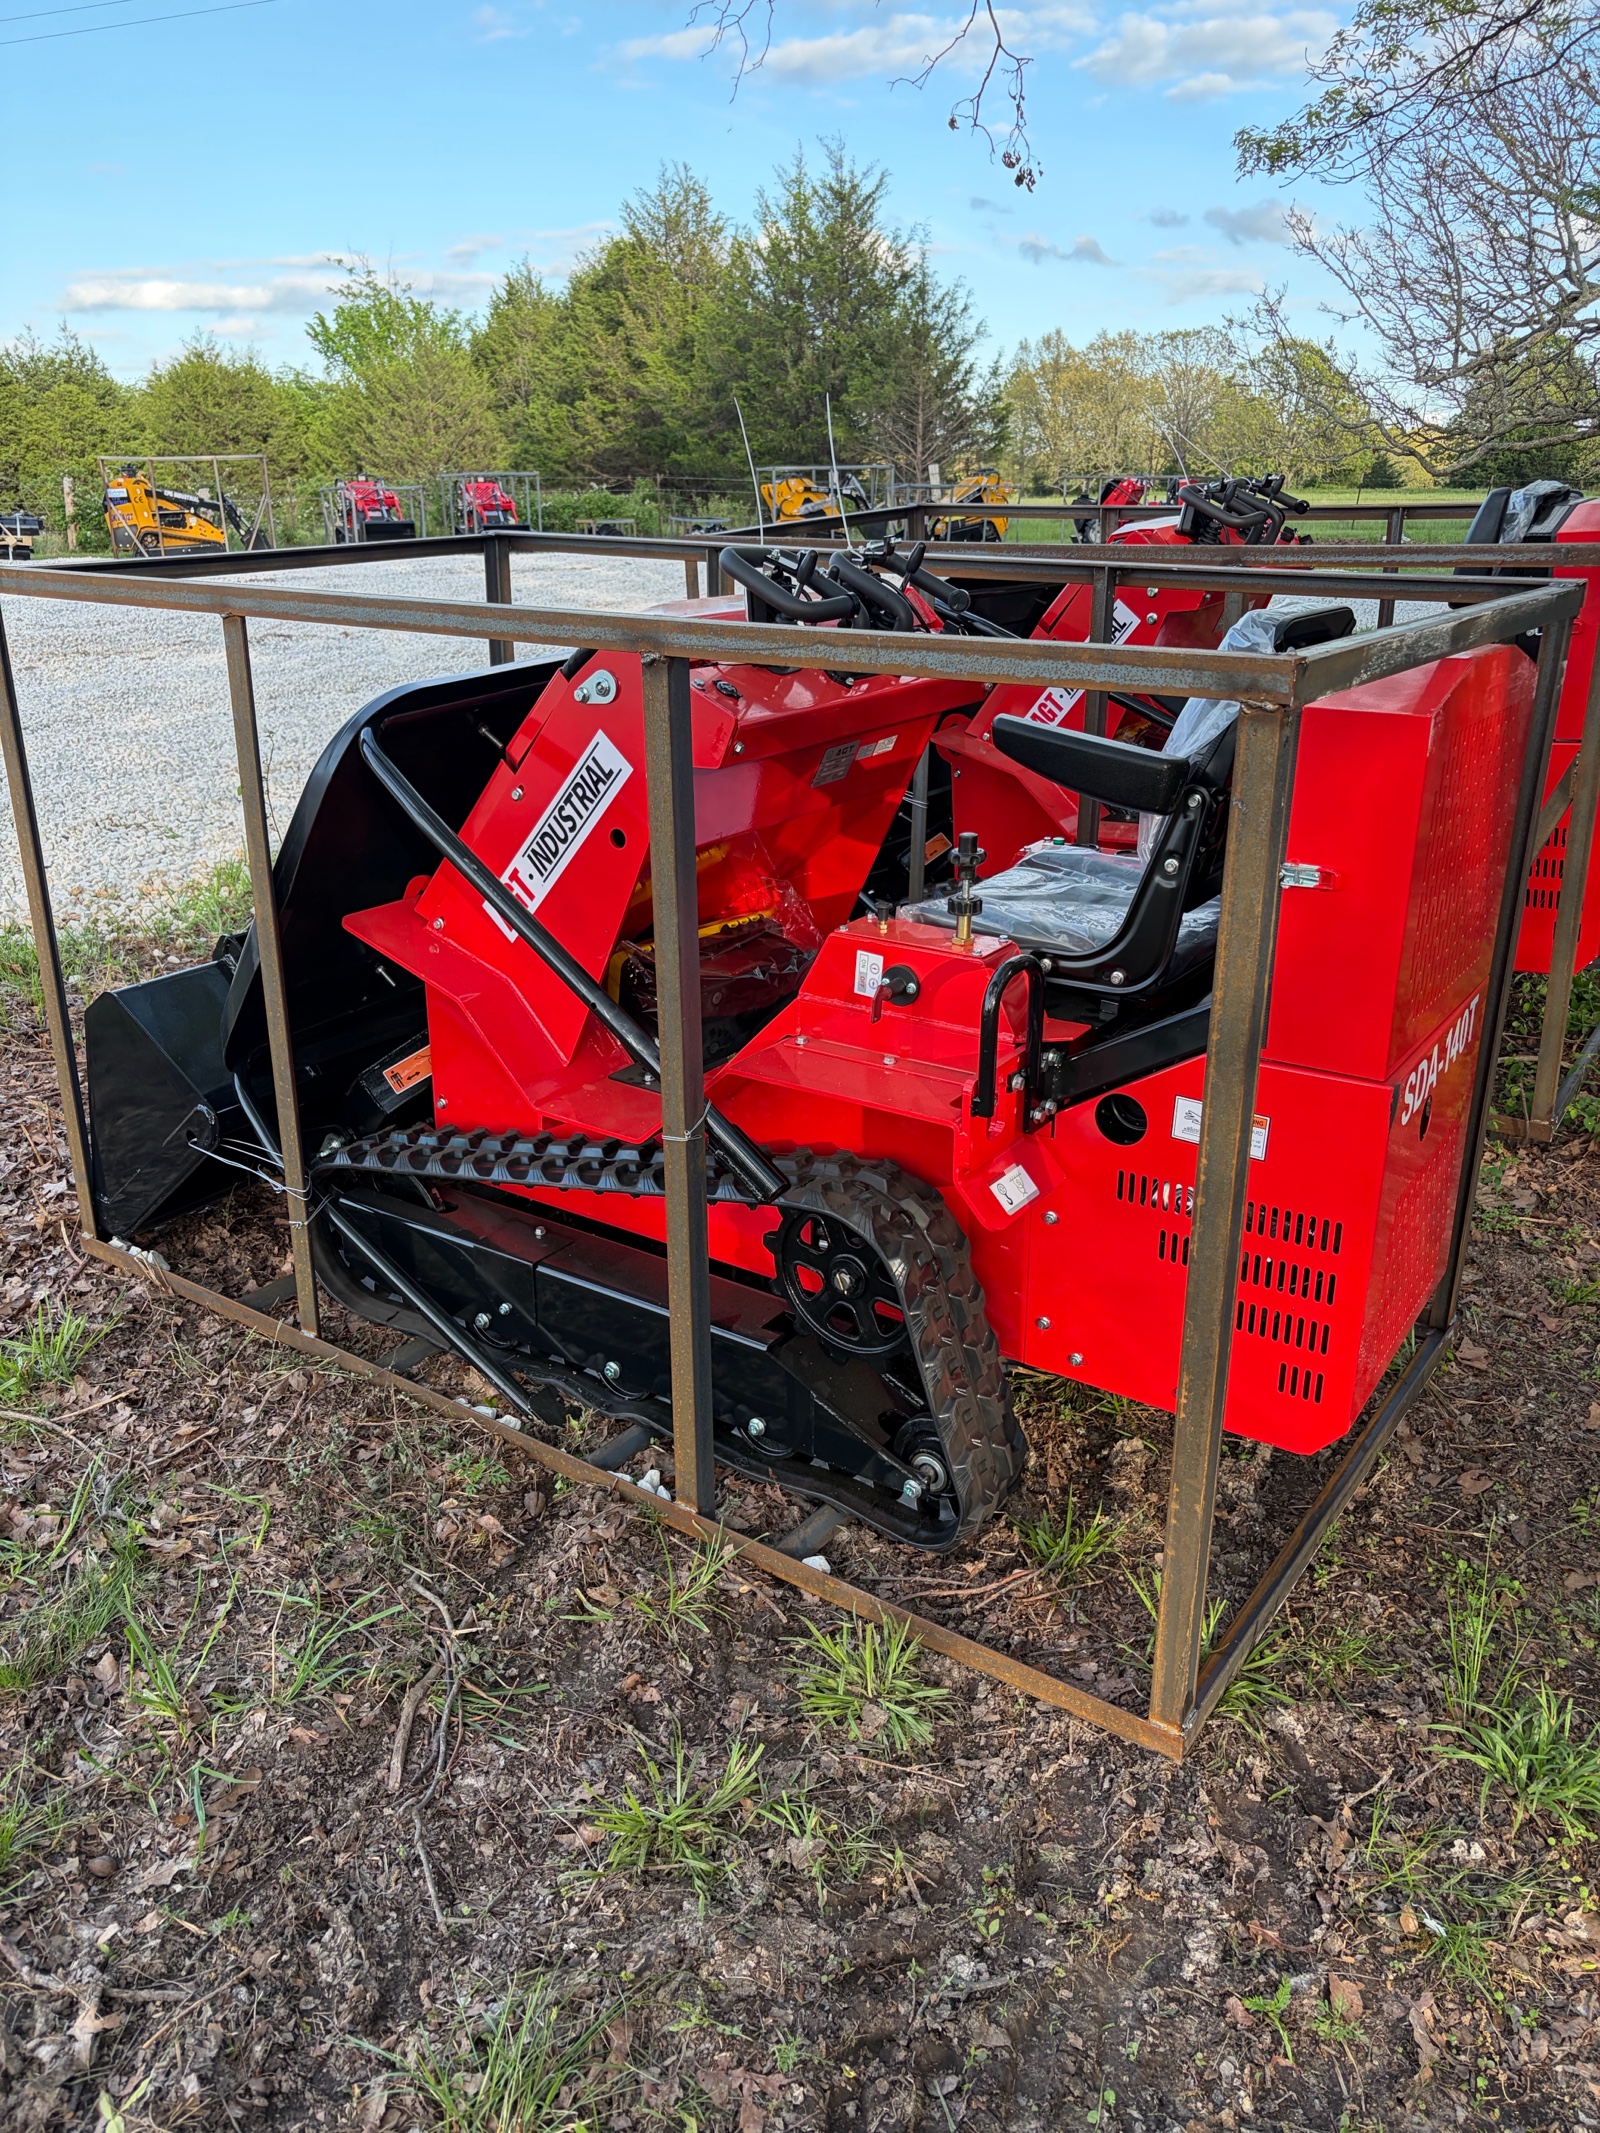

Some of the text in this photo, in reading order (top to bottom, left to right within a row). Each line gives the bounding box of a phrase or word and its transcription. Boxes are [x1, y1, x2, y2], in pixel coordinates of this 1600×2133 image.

[835, 745, 855, 757] AGT
[527, 756, 615, 876] INDUSTRIAL
[861, 959, 867, 969] ON
[1401, 993, 1480, 1126] SDA-140T
